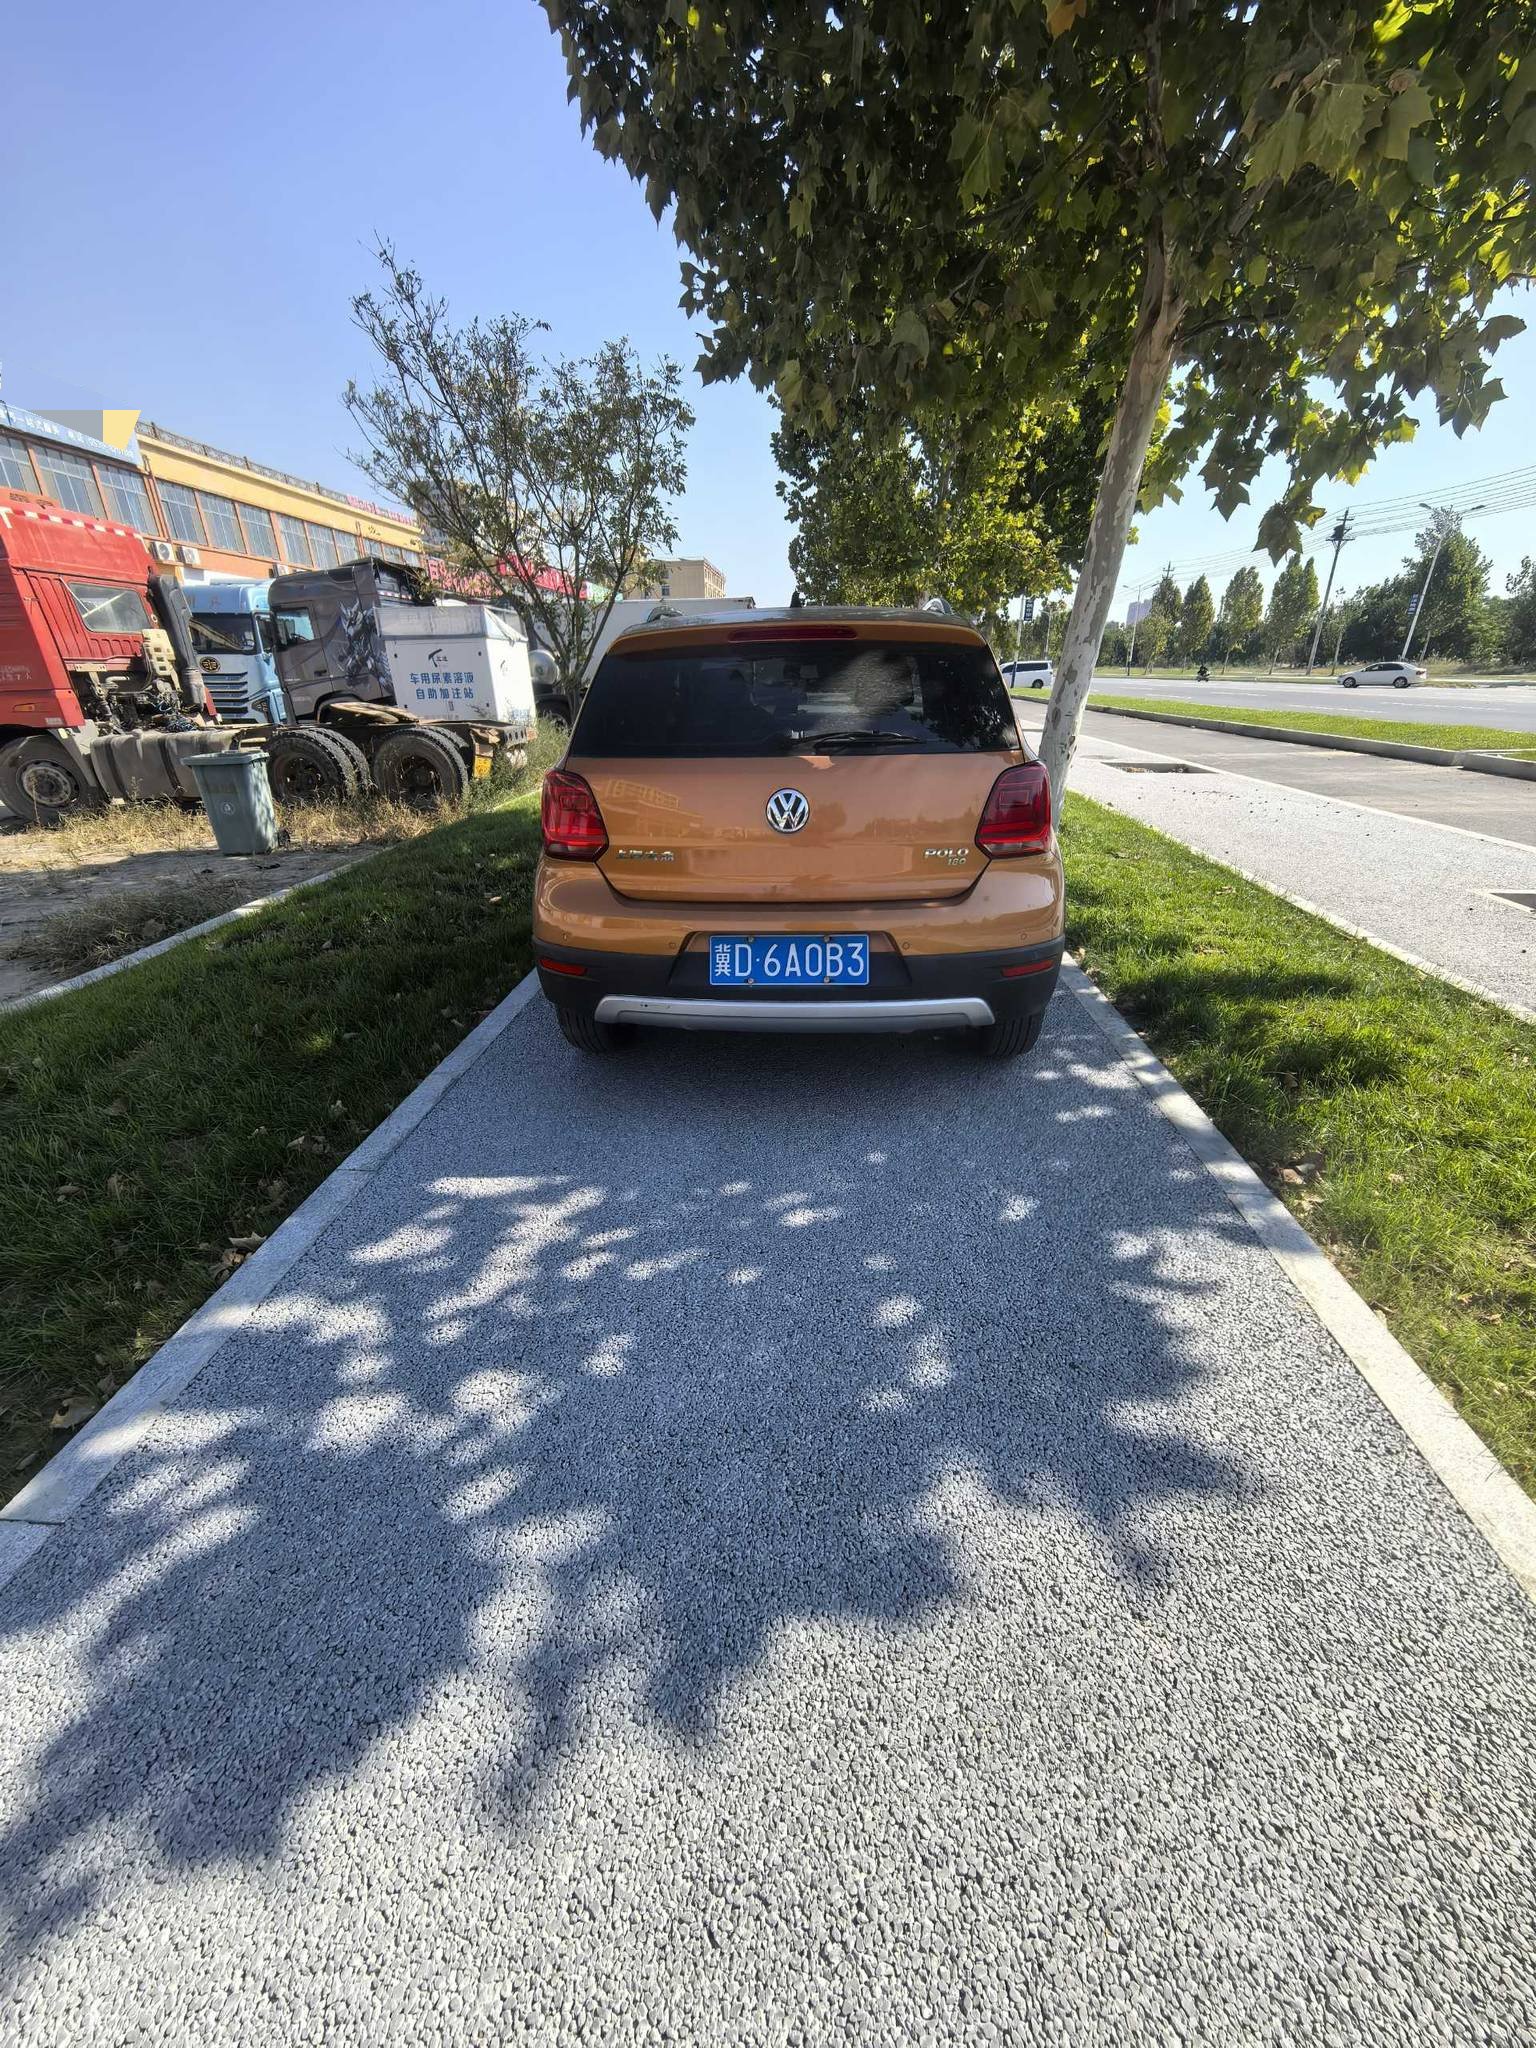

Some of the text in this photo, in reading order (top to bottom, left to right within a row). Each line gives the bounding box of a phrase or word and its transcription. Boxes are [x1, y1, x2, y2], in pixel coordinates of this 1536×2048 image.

[409, 672, 474, 684] 车用尿素溶液
[416, 687, 474, 700] 自助加注站
[924, 848, 969, 859] POLO
